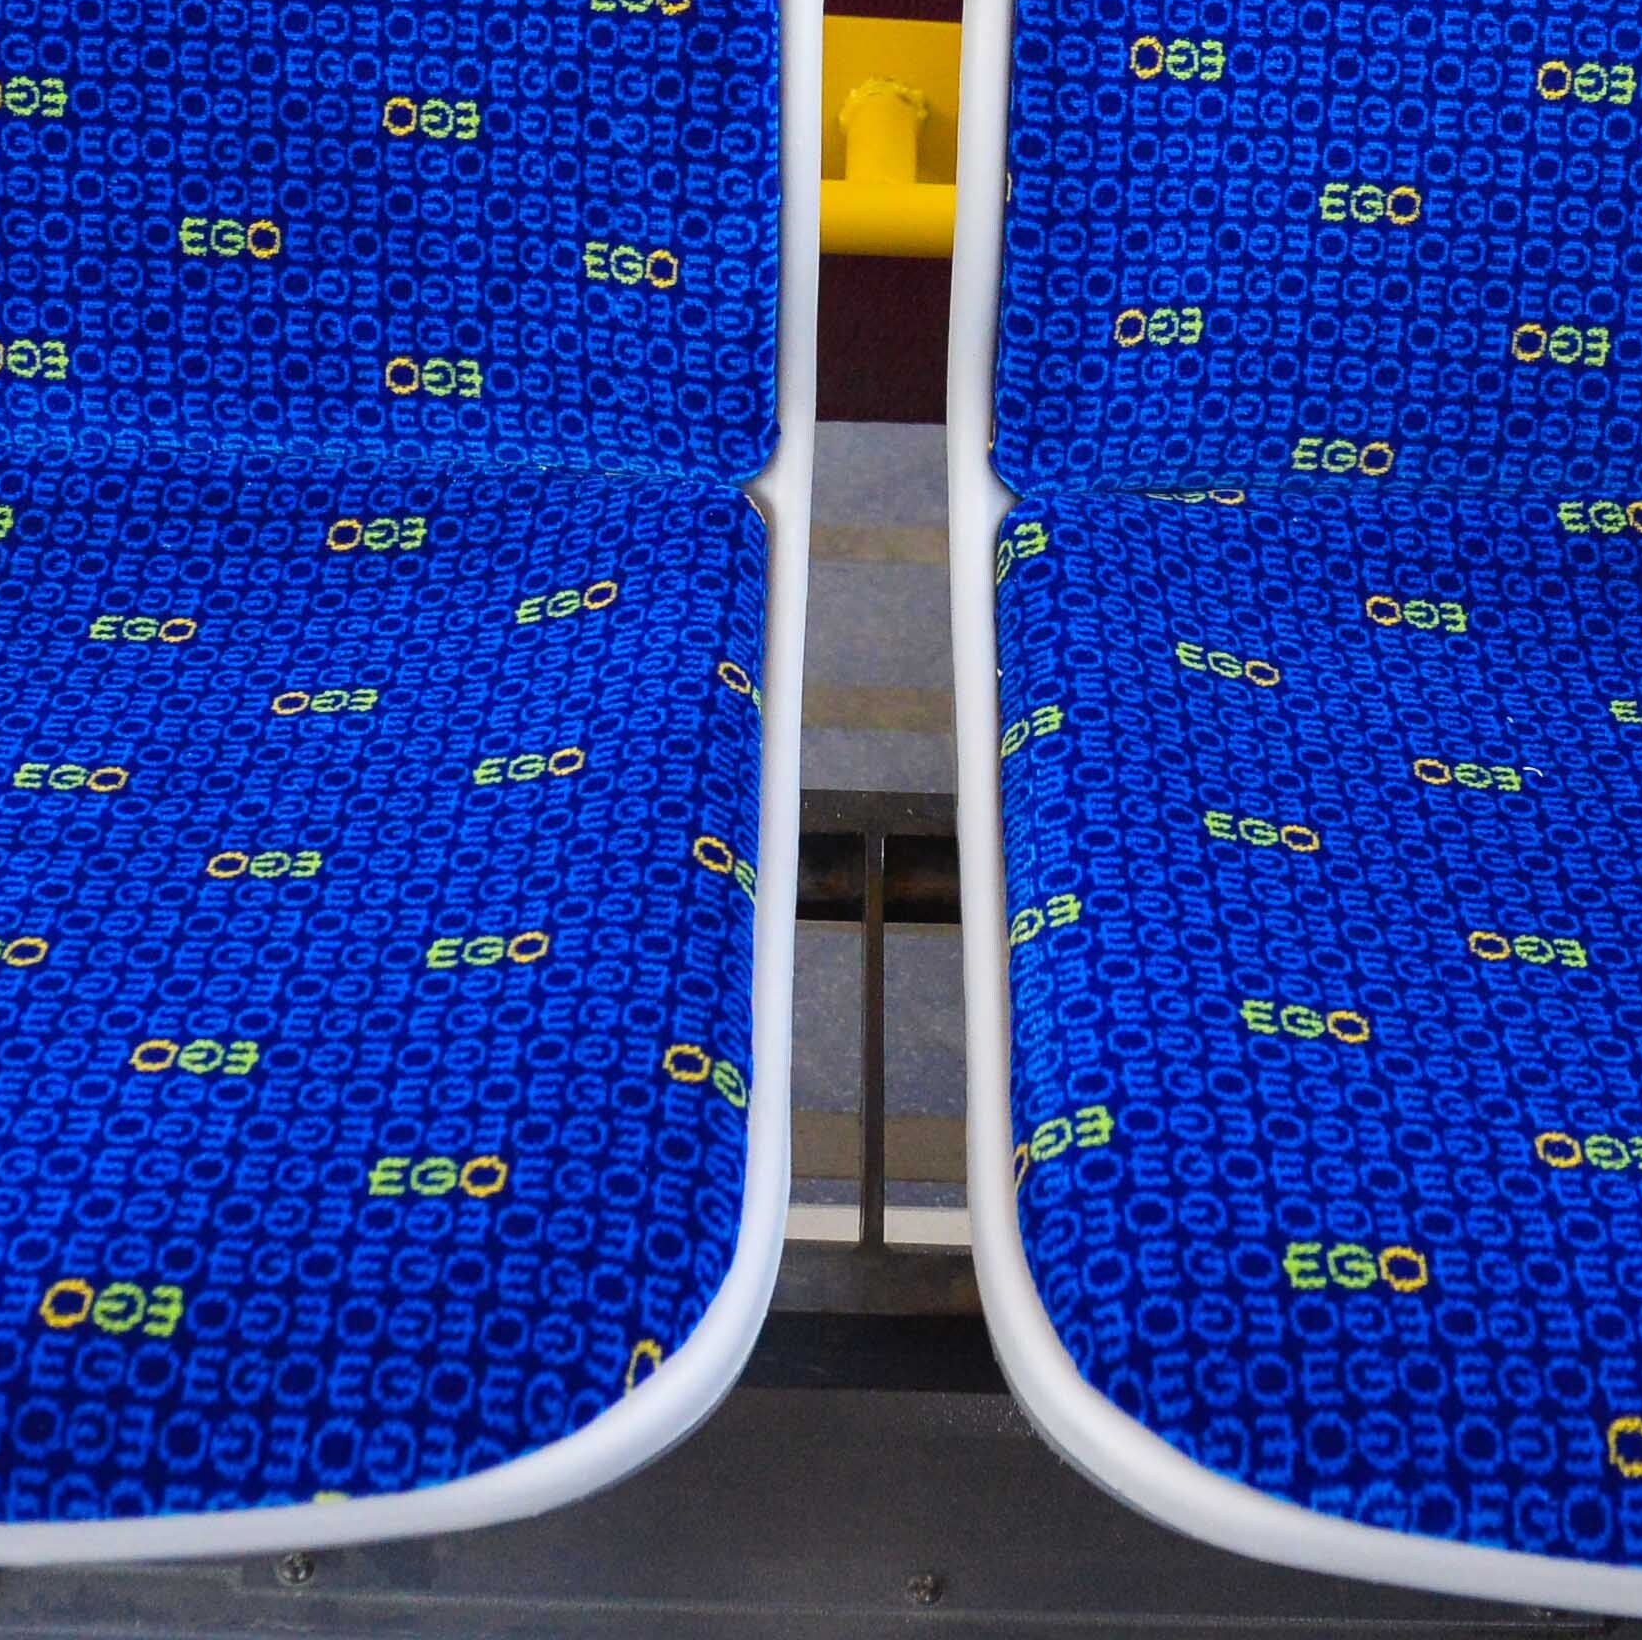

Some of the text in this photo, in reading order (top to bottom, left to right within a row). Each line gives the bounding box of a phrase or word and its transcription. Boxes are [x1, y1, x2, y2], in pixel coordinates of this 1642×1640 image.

[1321, 184, 1421, 224] EGO
[180, 218, 279, 258] EGO
[585, 243, 677, 288] EGO
[1291, 435, 1395, 477] EGO
[518, 582, 616, 623] EGO
[91, 617, 195, 642] EGO
[1178, 644, 1278, 685] EGO
[15, 764, 127, 791] EGO
[475, 748, 583, 784] EGO
[1205, 812, 1319, 851] EGO
[428, 933, 548, 968] EGO
[1242, 1001, 1369, 1042] EGO
[370, 1157, 507, 1197] EGO
[1284, 1244, 1428, 1291] EGO
